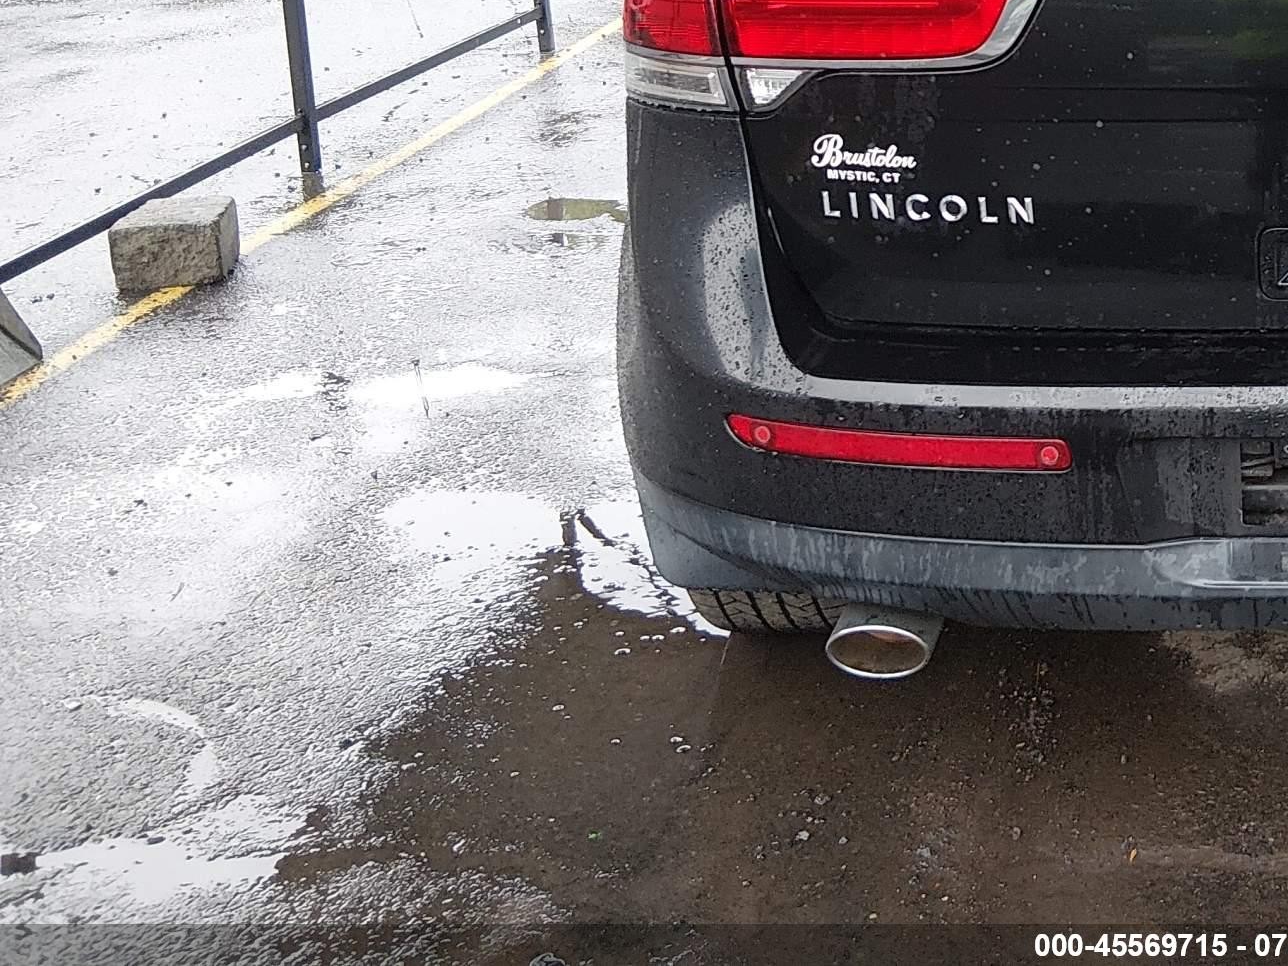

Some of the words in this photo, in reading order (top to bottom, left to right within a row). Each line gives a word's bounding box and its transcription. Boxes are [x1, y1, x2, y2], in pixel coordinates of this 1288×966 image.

[811, 134, 916, 168] Brustolon
[826, 169, 880, 183] MYSTIC,
[882, 170, 901, 183] CT
[821, 191, 1034, 224] LINCOLN
